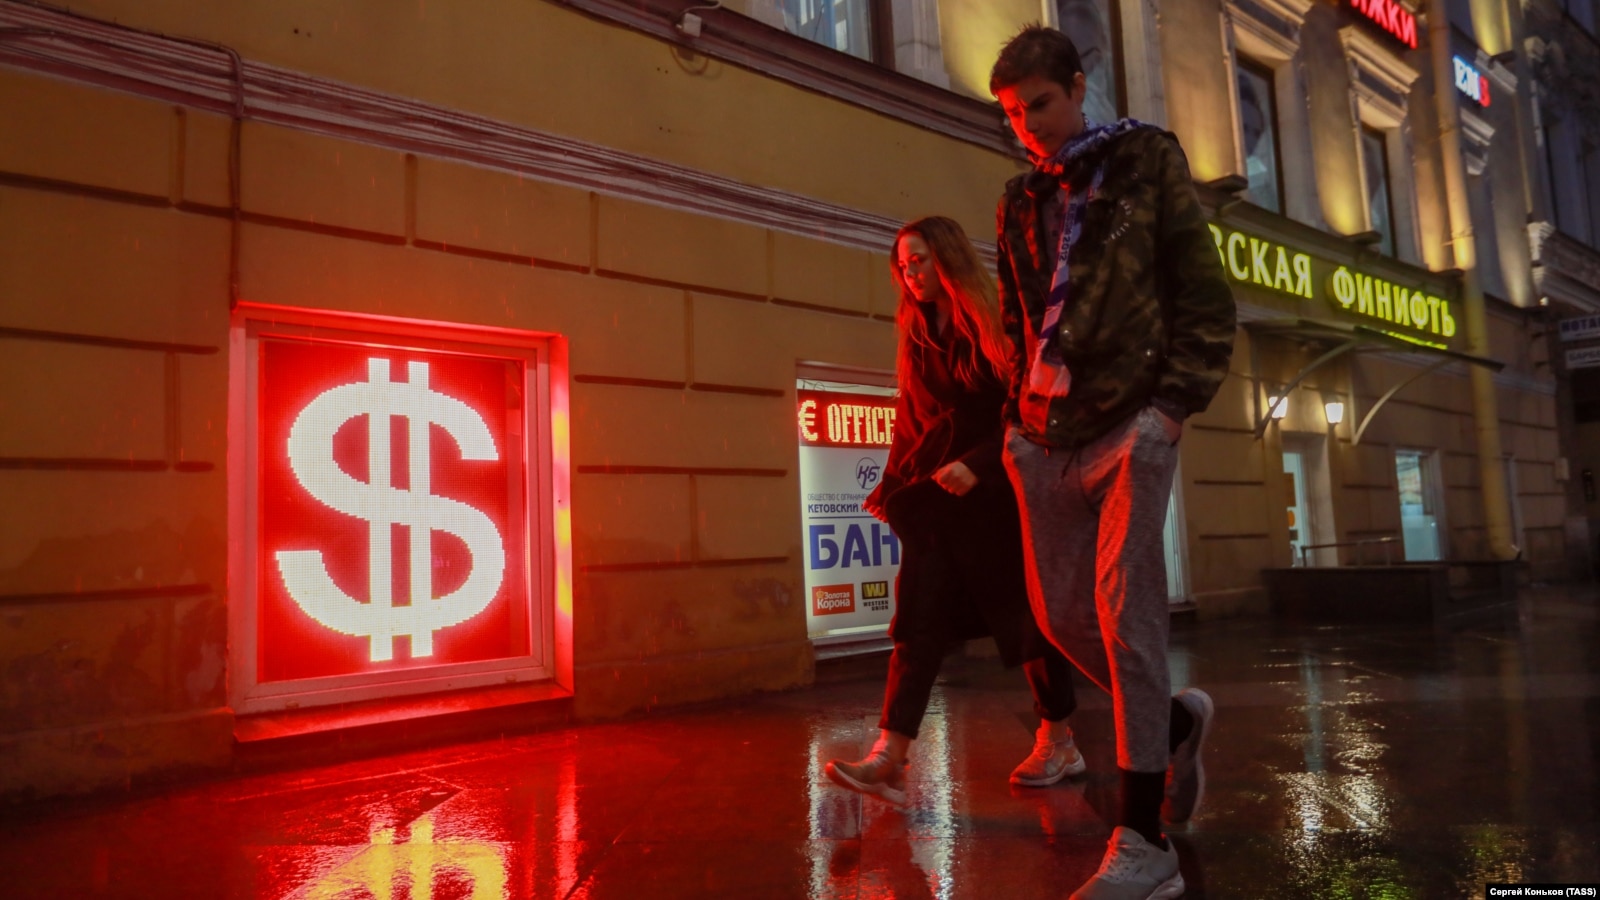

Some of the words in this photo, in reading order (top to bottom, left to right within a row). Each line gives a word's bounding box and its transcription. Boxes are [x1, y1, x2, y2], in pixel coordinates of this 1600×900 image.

[1349, 0, 1418, 49] ЖКИ
[1332, 265, 1456, 337] ФИНИФТЬ
[1561, 317, 1600, 332] НОТА
[798, 400, 819, 441] €
[827, 404, 896, 445] OFFICE
[808, 493, 835, 501] ОБЩЕСТВО
[808, 503, 859, 513] КЕТОВСКИЙ
[809, 523, 899, 570] БАН
[824, 592, 850, 600] Золотая
[817, 598, 851, 610] Корона
